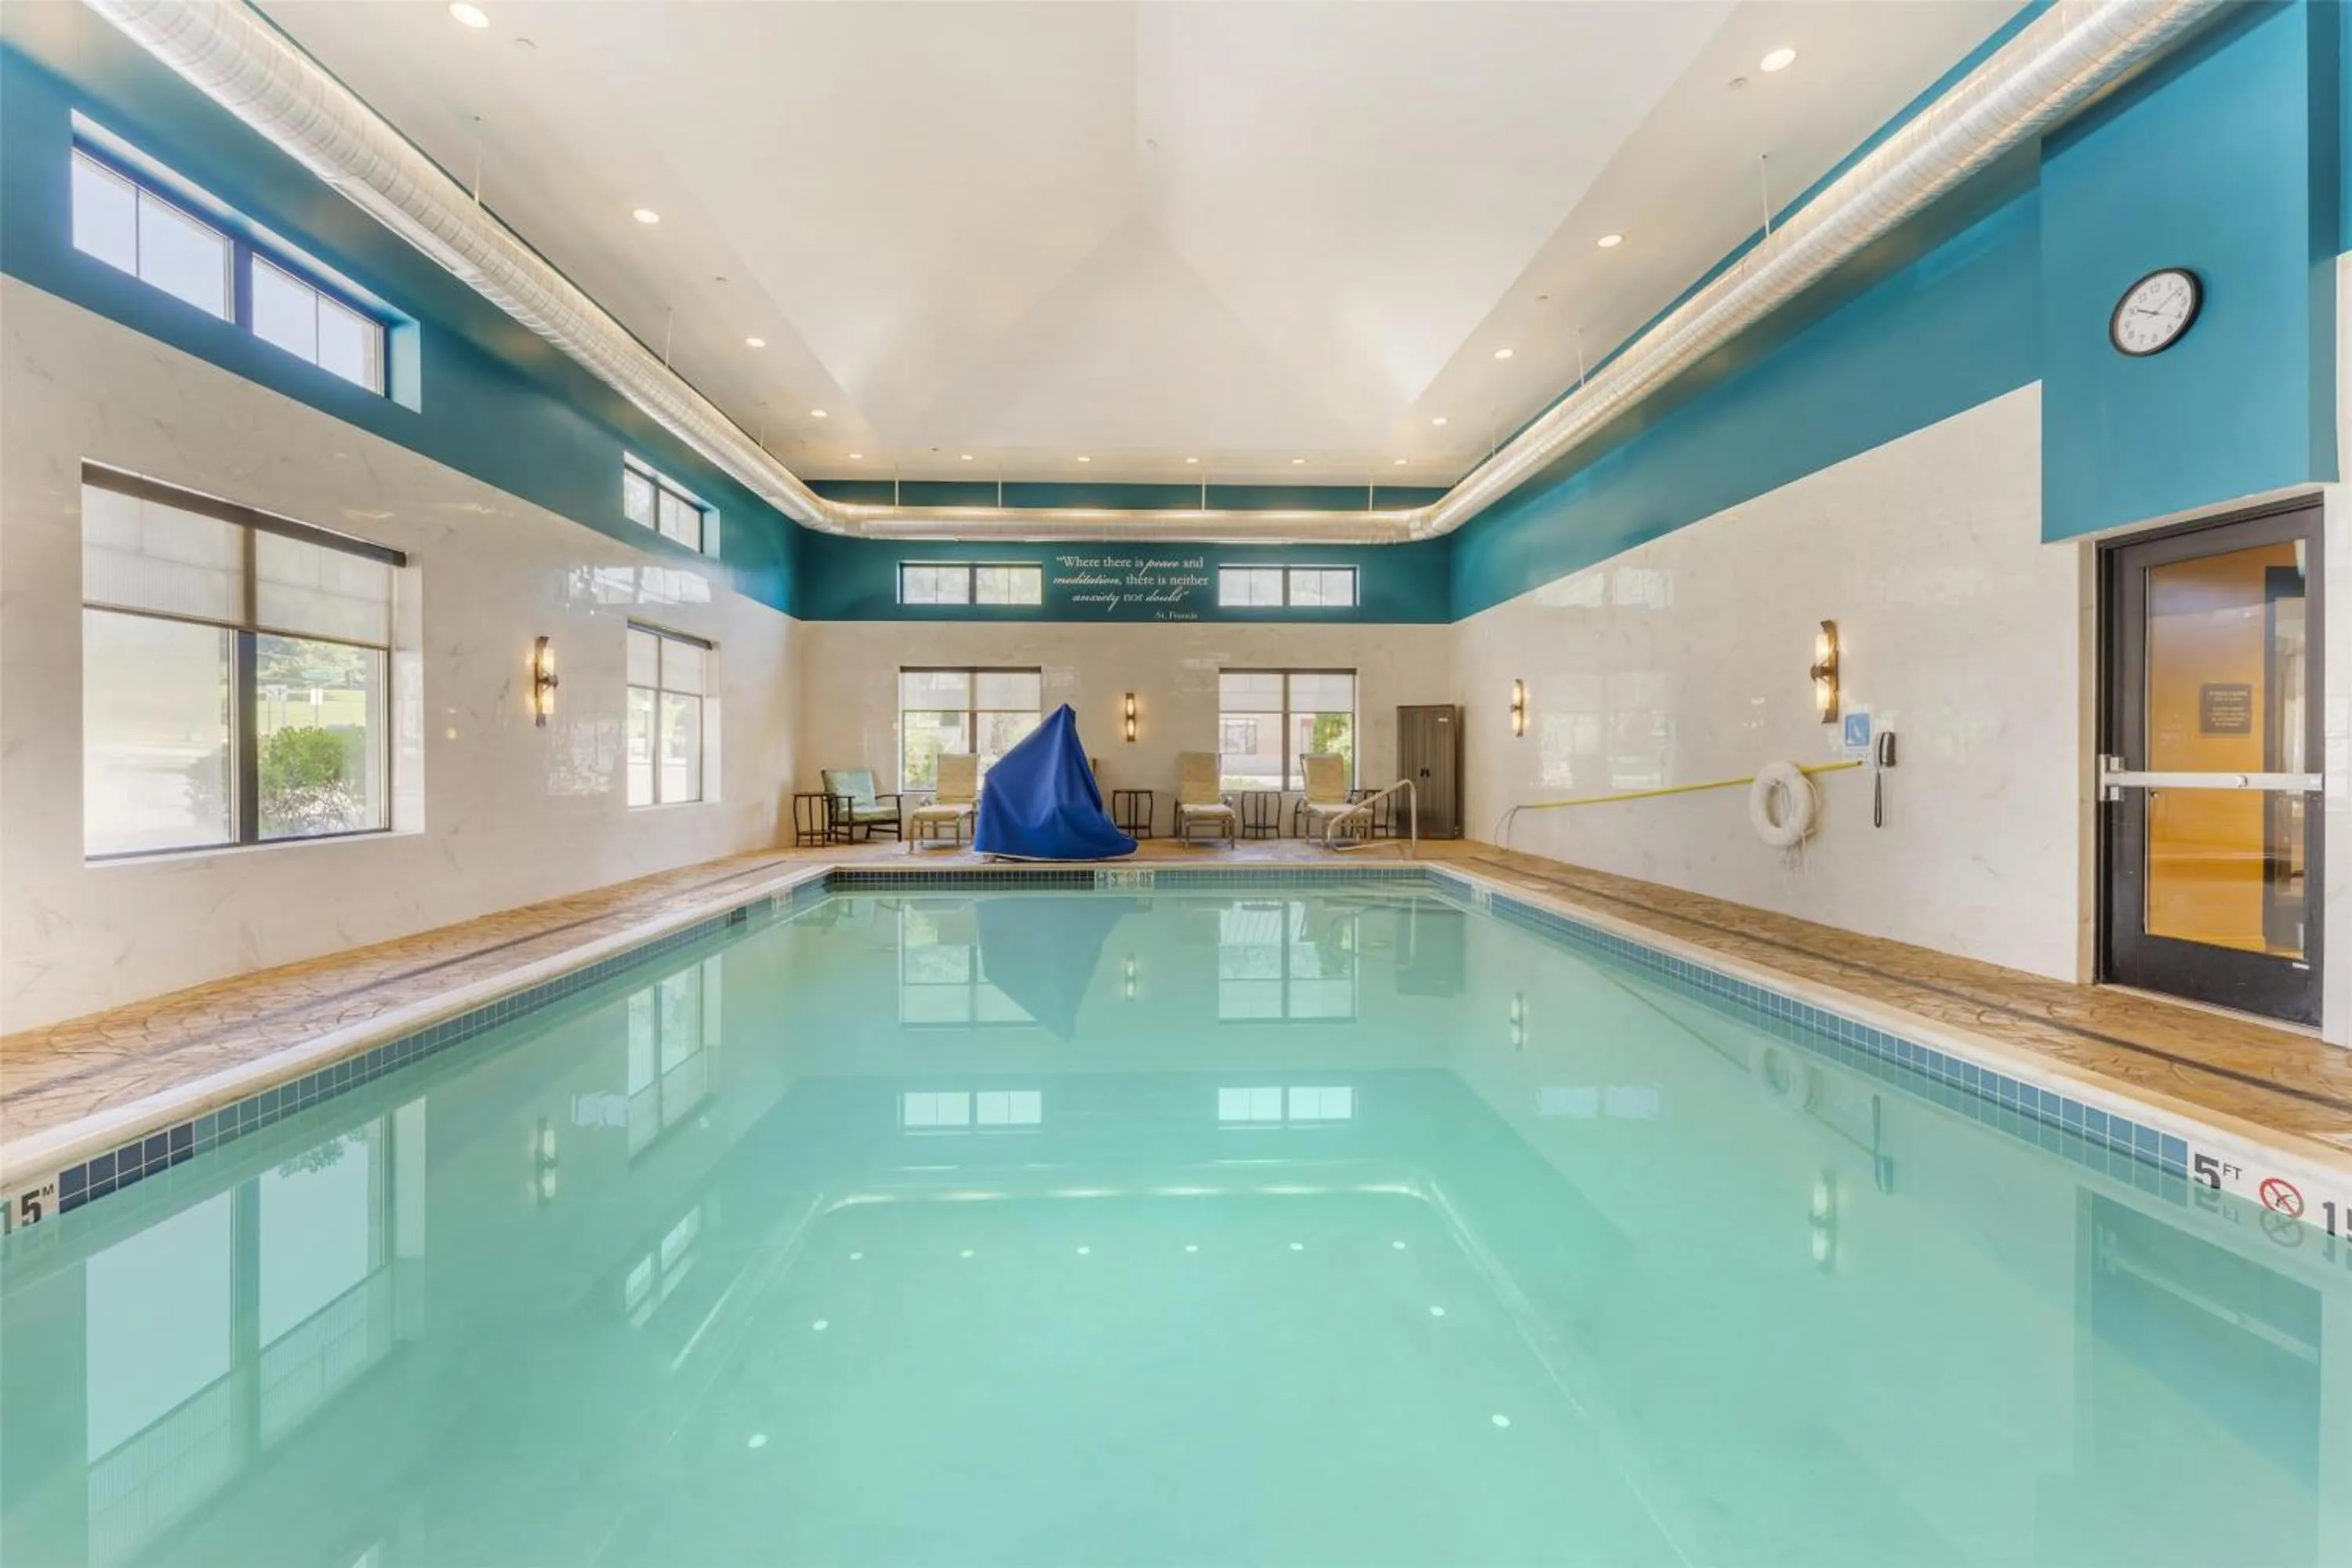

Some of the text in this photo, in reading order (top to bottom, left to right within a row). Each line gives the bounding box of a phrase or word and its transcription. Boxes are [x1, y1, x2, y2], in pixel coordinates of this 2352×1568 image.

[1103, 555, 1131, 568] there
[1135, 557, 1144, 568] is
[1139, 557, 1179, 577] peace
[1183, 556, 1203, 568] and
[1053, 571, 1209, 586] meditation, there is neither
[1072, 591, 1120, 612] anxiety
[2194, 1152, 2243, 1189] 5 FT
[42, 1183, 54, 1197] M
